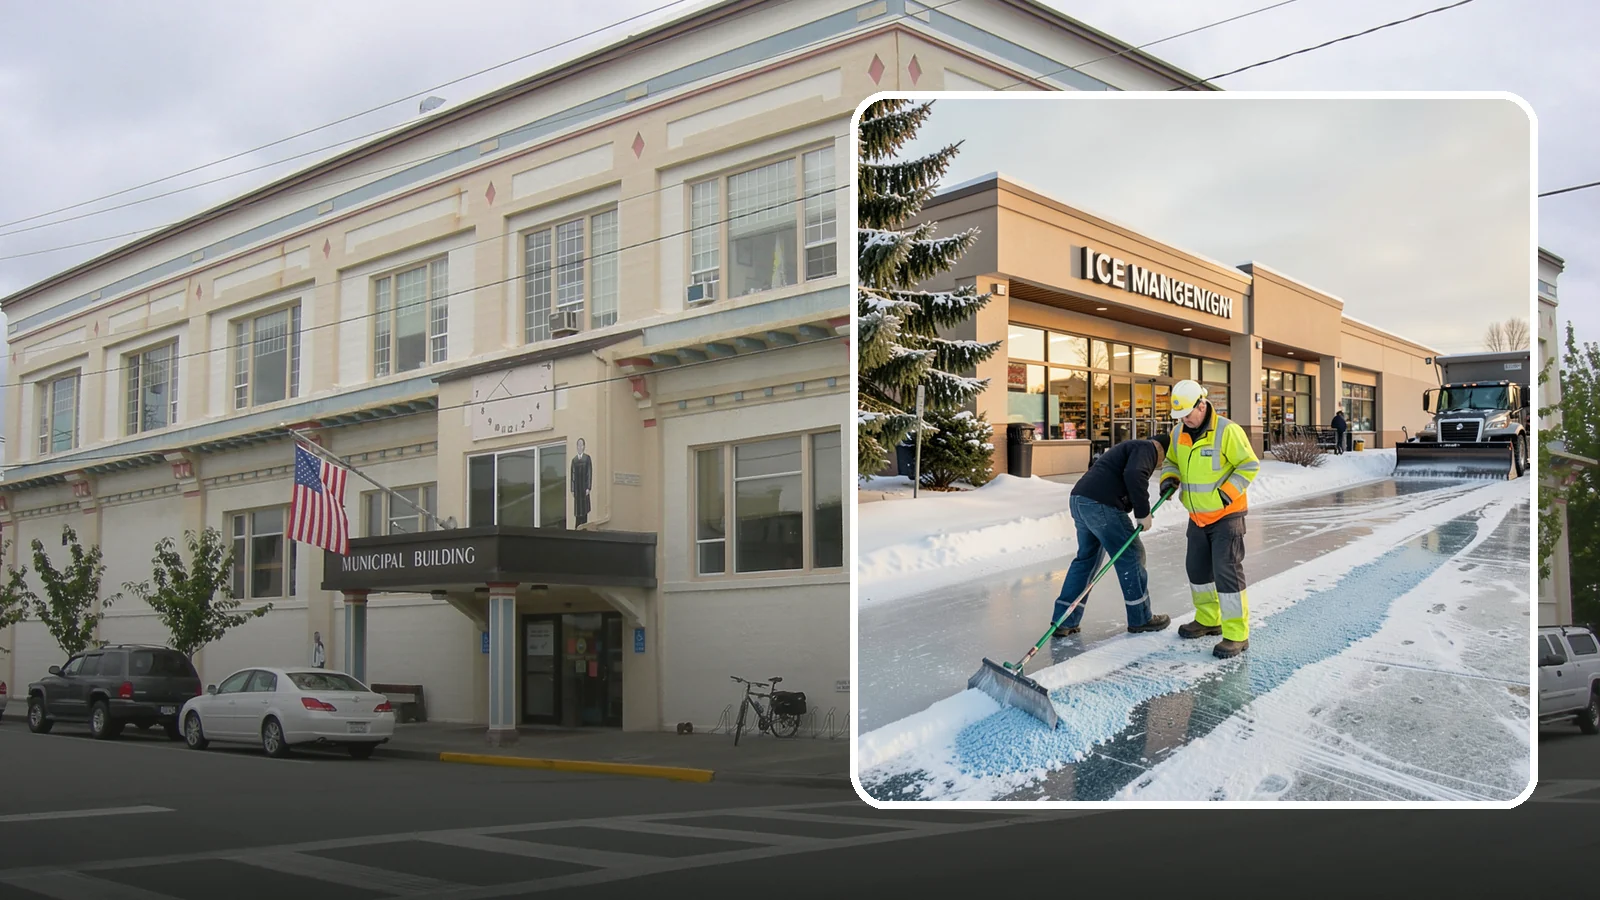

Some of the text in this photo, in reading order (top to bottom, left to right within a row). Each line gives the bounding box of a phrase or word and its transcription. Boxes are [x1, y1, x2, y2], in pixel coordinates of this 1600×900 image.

[1085, 246, 1125, 288] ICE
[480, 407, 485, 415] 8
[488, 417, 492, 426] 9
[494, 423, 500, 431] 10
[501, 425, 506, 433] 11
[507, 425, 513, 433] 12
[521, 420, 526, 428] 2
[529, 414, 533, 422] 3
[536, 402, 540, 410] 4
[342, 546, 475, 572] MUNICIPAL BUILDING
